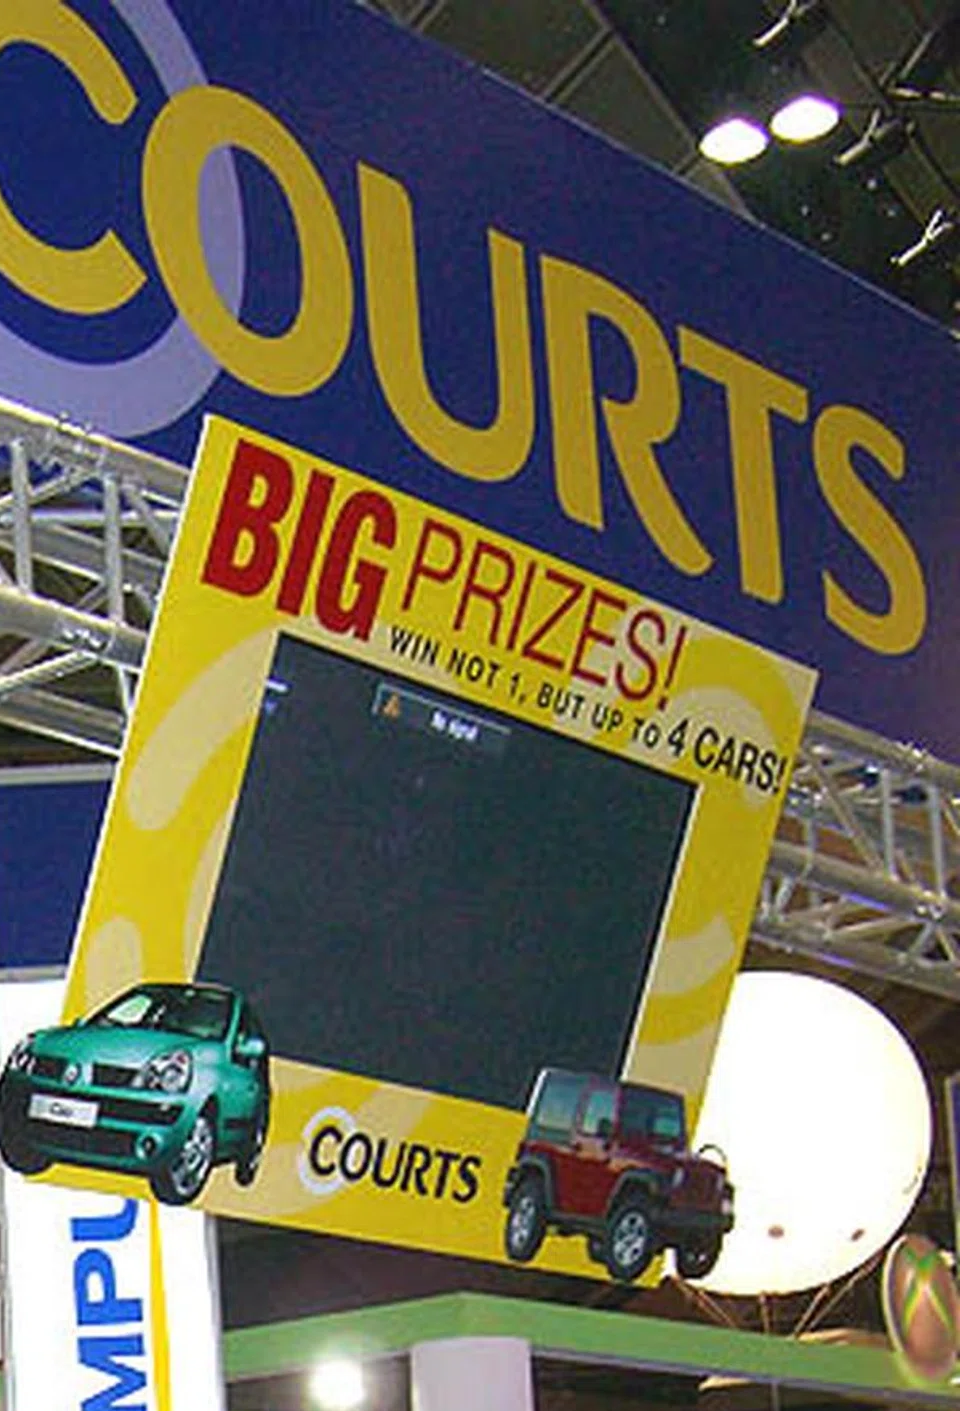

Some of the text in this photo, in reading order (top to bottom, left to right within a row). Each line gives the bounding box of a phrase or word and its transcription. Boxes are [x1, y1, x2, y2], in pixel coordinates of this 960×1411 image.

[199, 437, 689, 711] BIG PRIZES!
[388, 625, 441, 667] WIN
[448, 646, 501, 690] NOT
[535, 683, 586, 721] BUT
[590, 706, 625, 733] UP
[628, 714, 662, 748] TO
[667, 718, 691, 757] 4
[693, 726, 789, 796] CARS!
[309, 1125, 482, 1204] COURTS
